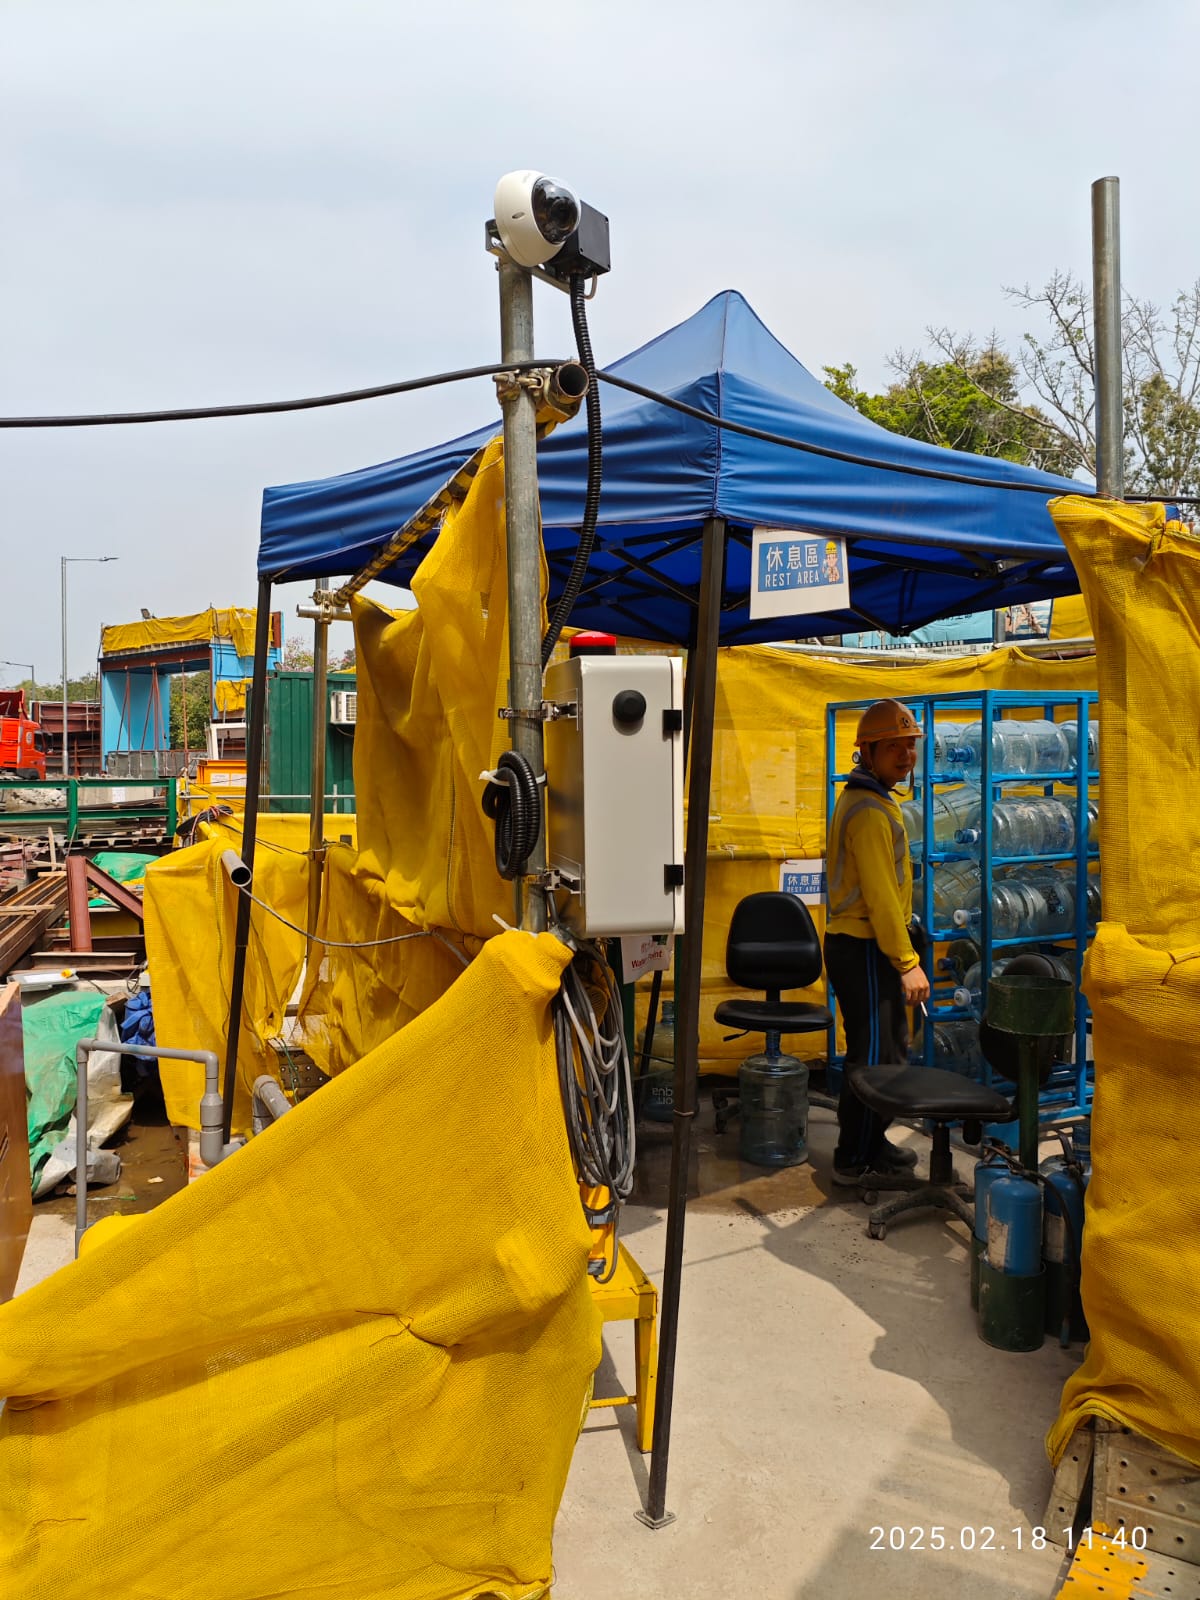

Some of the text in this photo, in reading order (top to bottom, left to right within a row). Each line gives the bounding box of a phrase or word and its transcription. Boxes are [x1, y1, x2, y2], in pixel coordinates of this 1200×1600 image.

[766, 544, 819, 572] 休息區
[765, 570, 819, 588] REST AREA
